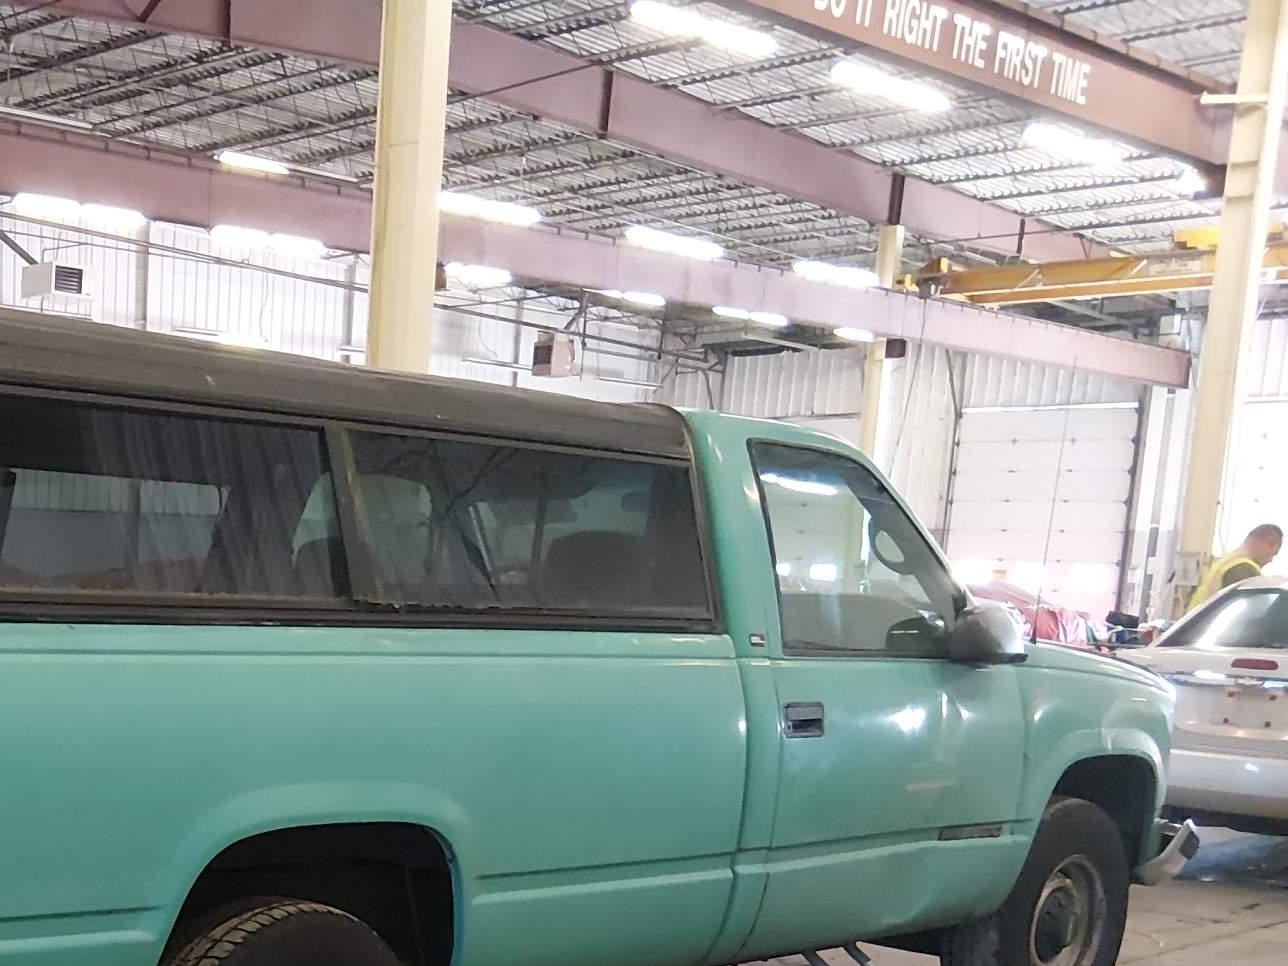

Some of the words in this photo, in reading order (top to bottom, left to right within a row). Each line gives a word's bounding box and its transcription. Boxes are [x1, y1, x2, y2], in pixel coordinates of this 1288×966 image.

[882, 0, 948, 52] RIGHT
[952, 14, 992, 68] THE
[994, 31, 1048, 88] FIRST
[1050, 52, 1091, 104] TIME
